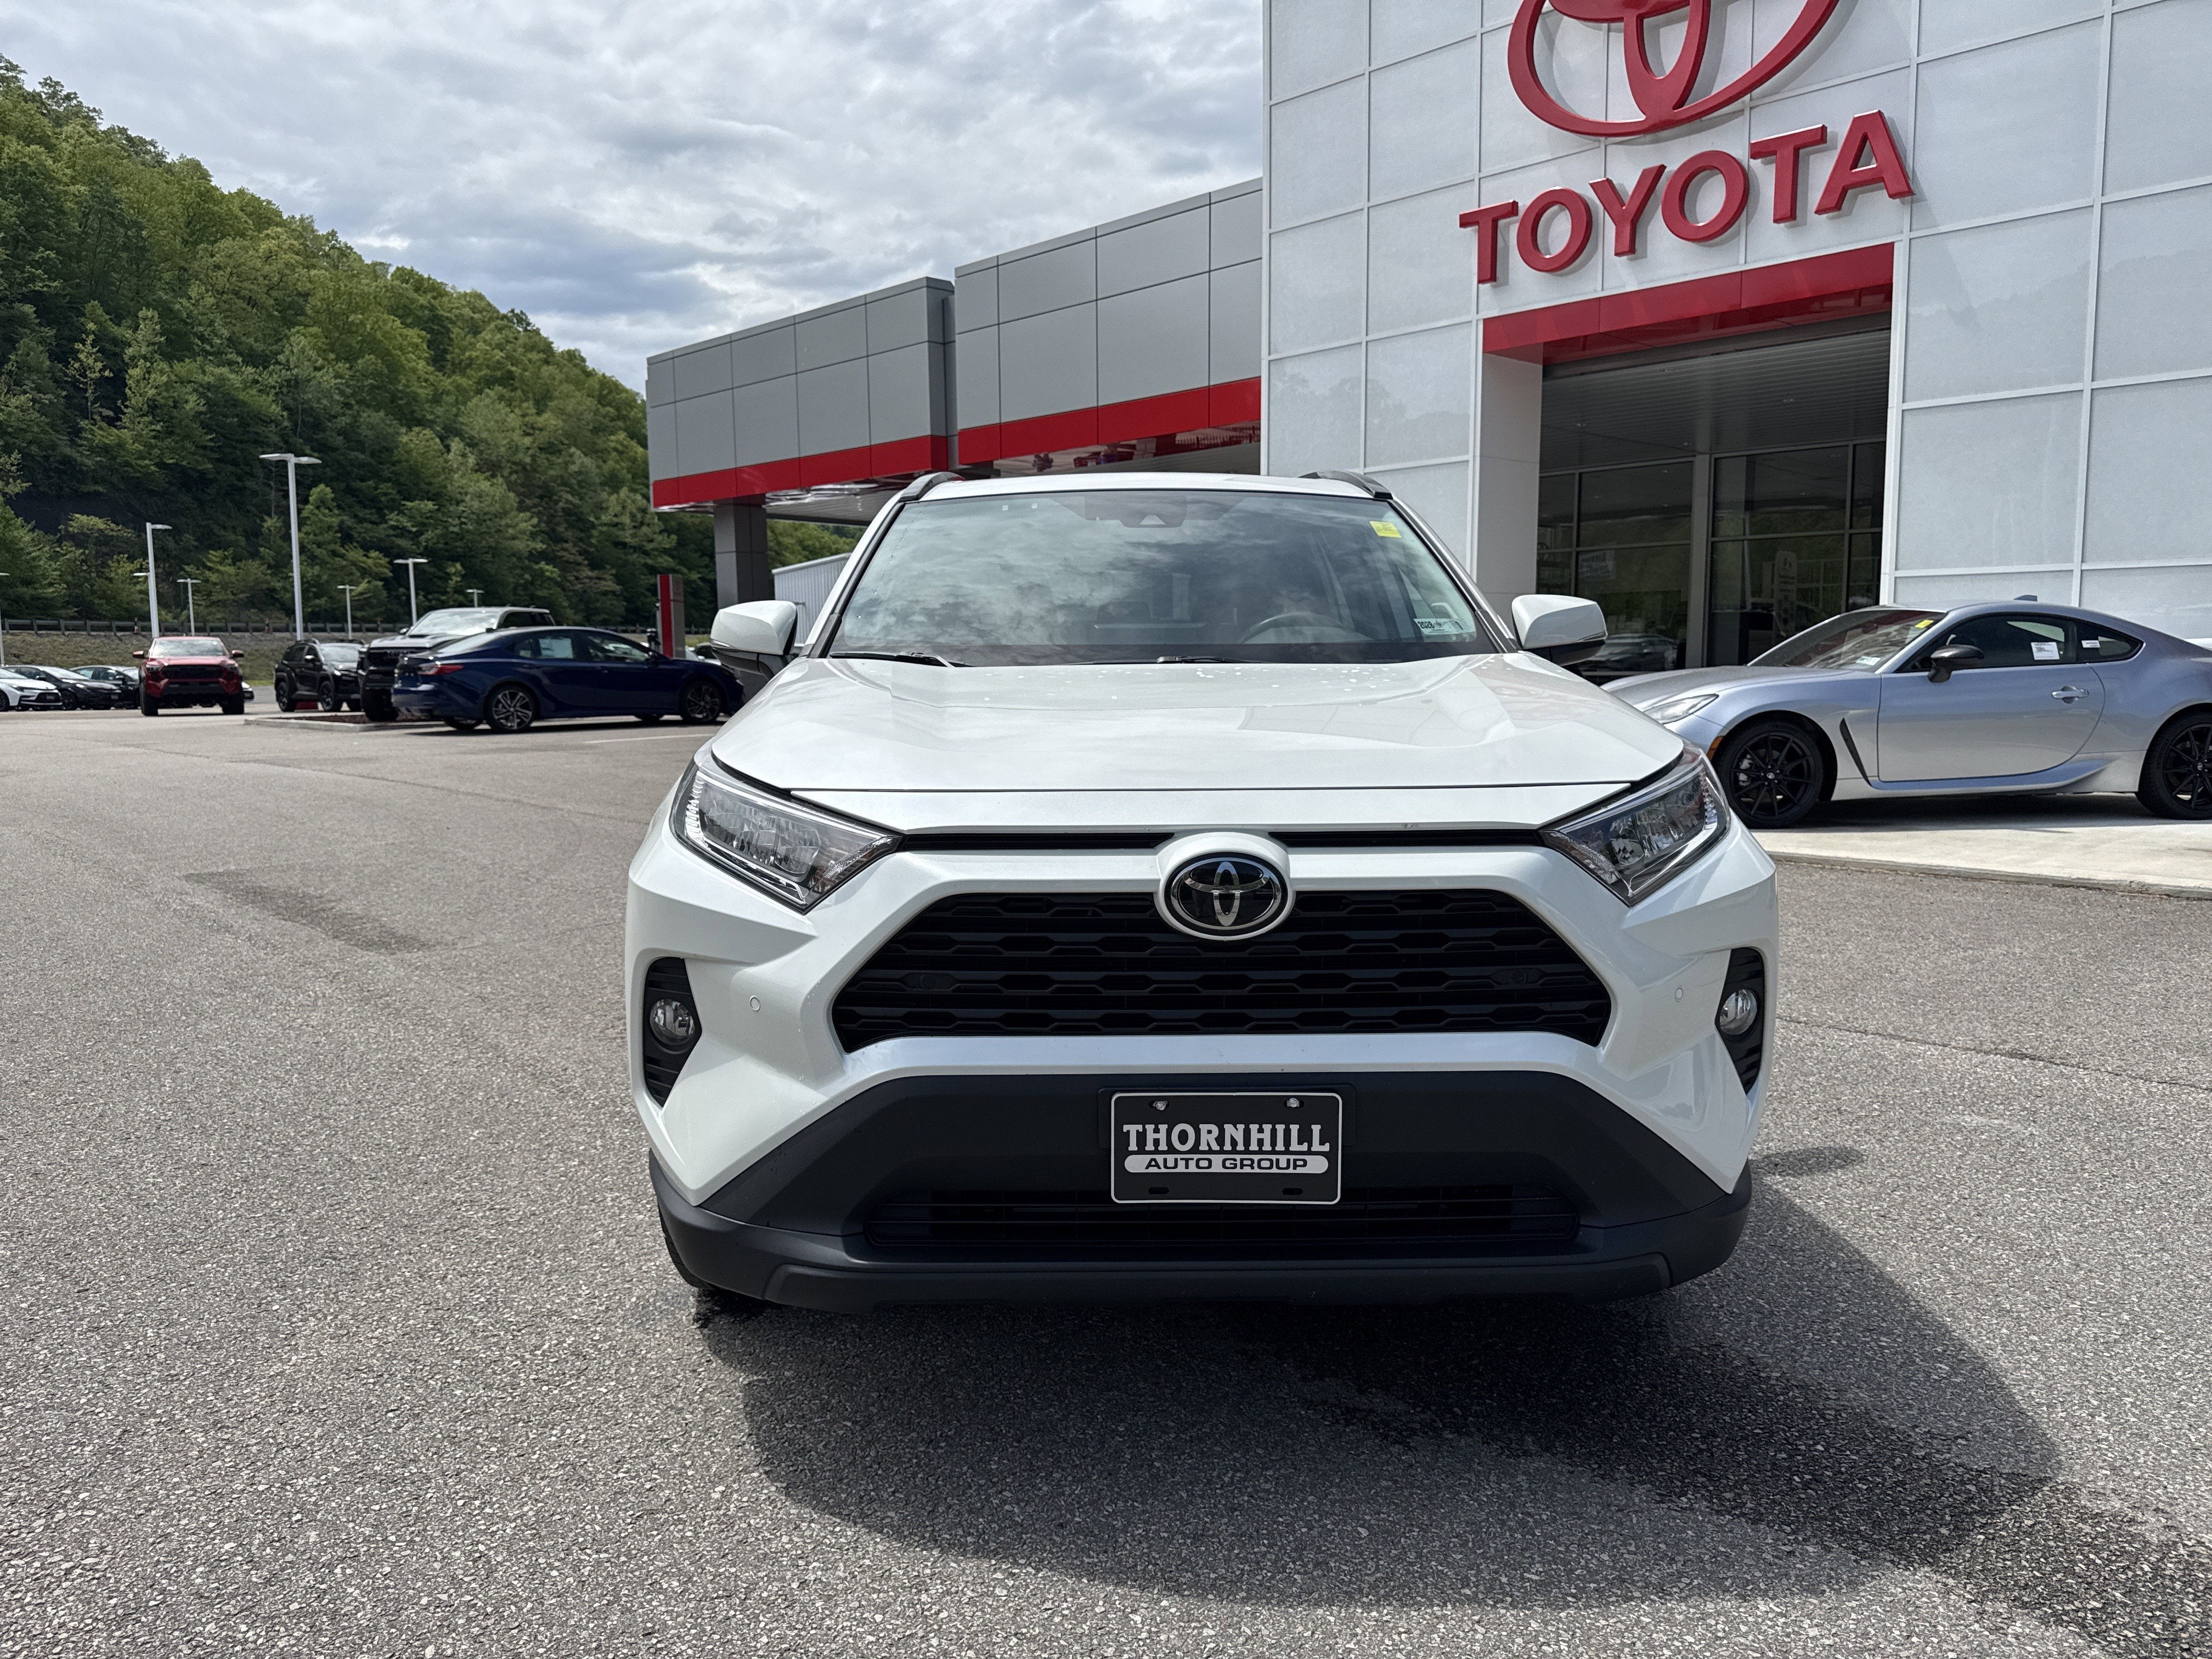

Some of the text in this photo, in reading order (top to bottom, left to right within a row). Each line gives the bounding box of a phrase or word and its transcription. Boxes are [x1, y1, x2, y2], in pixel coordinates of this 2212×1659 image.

[1459, 110, 1914, 284] TOYOTA
[1123, 1123, 1330, 1152] THORNHILL
[1145, 1158, 1307, 1170] AUTO GROUP
